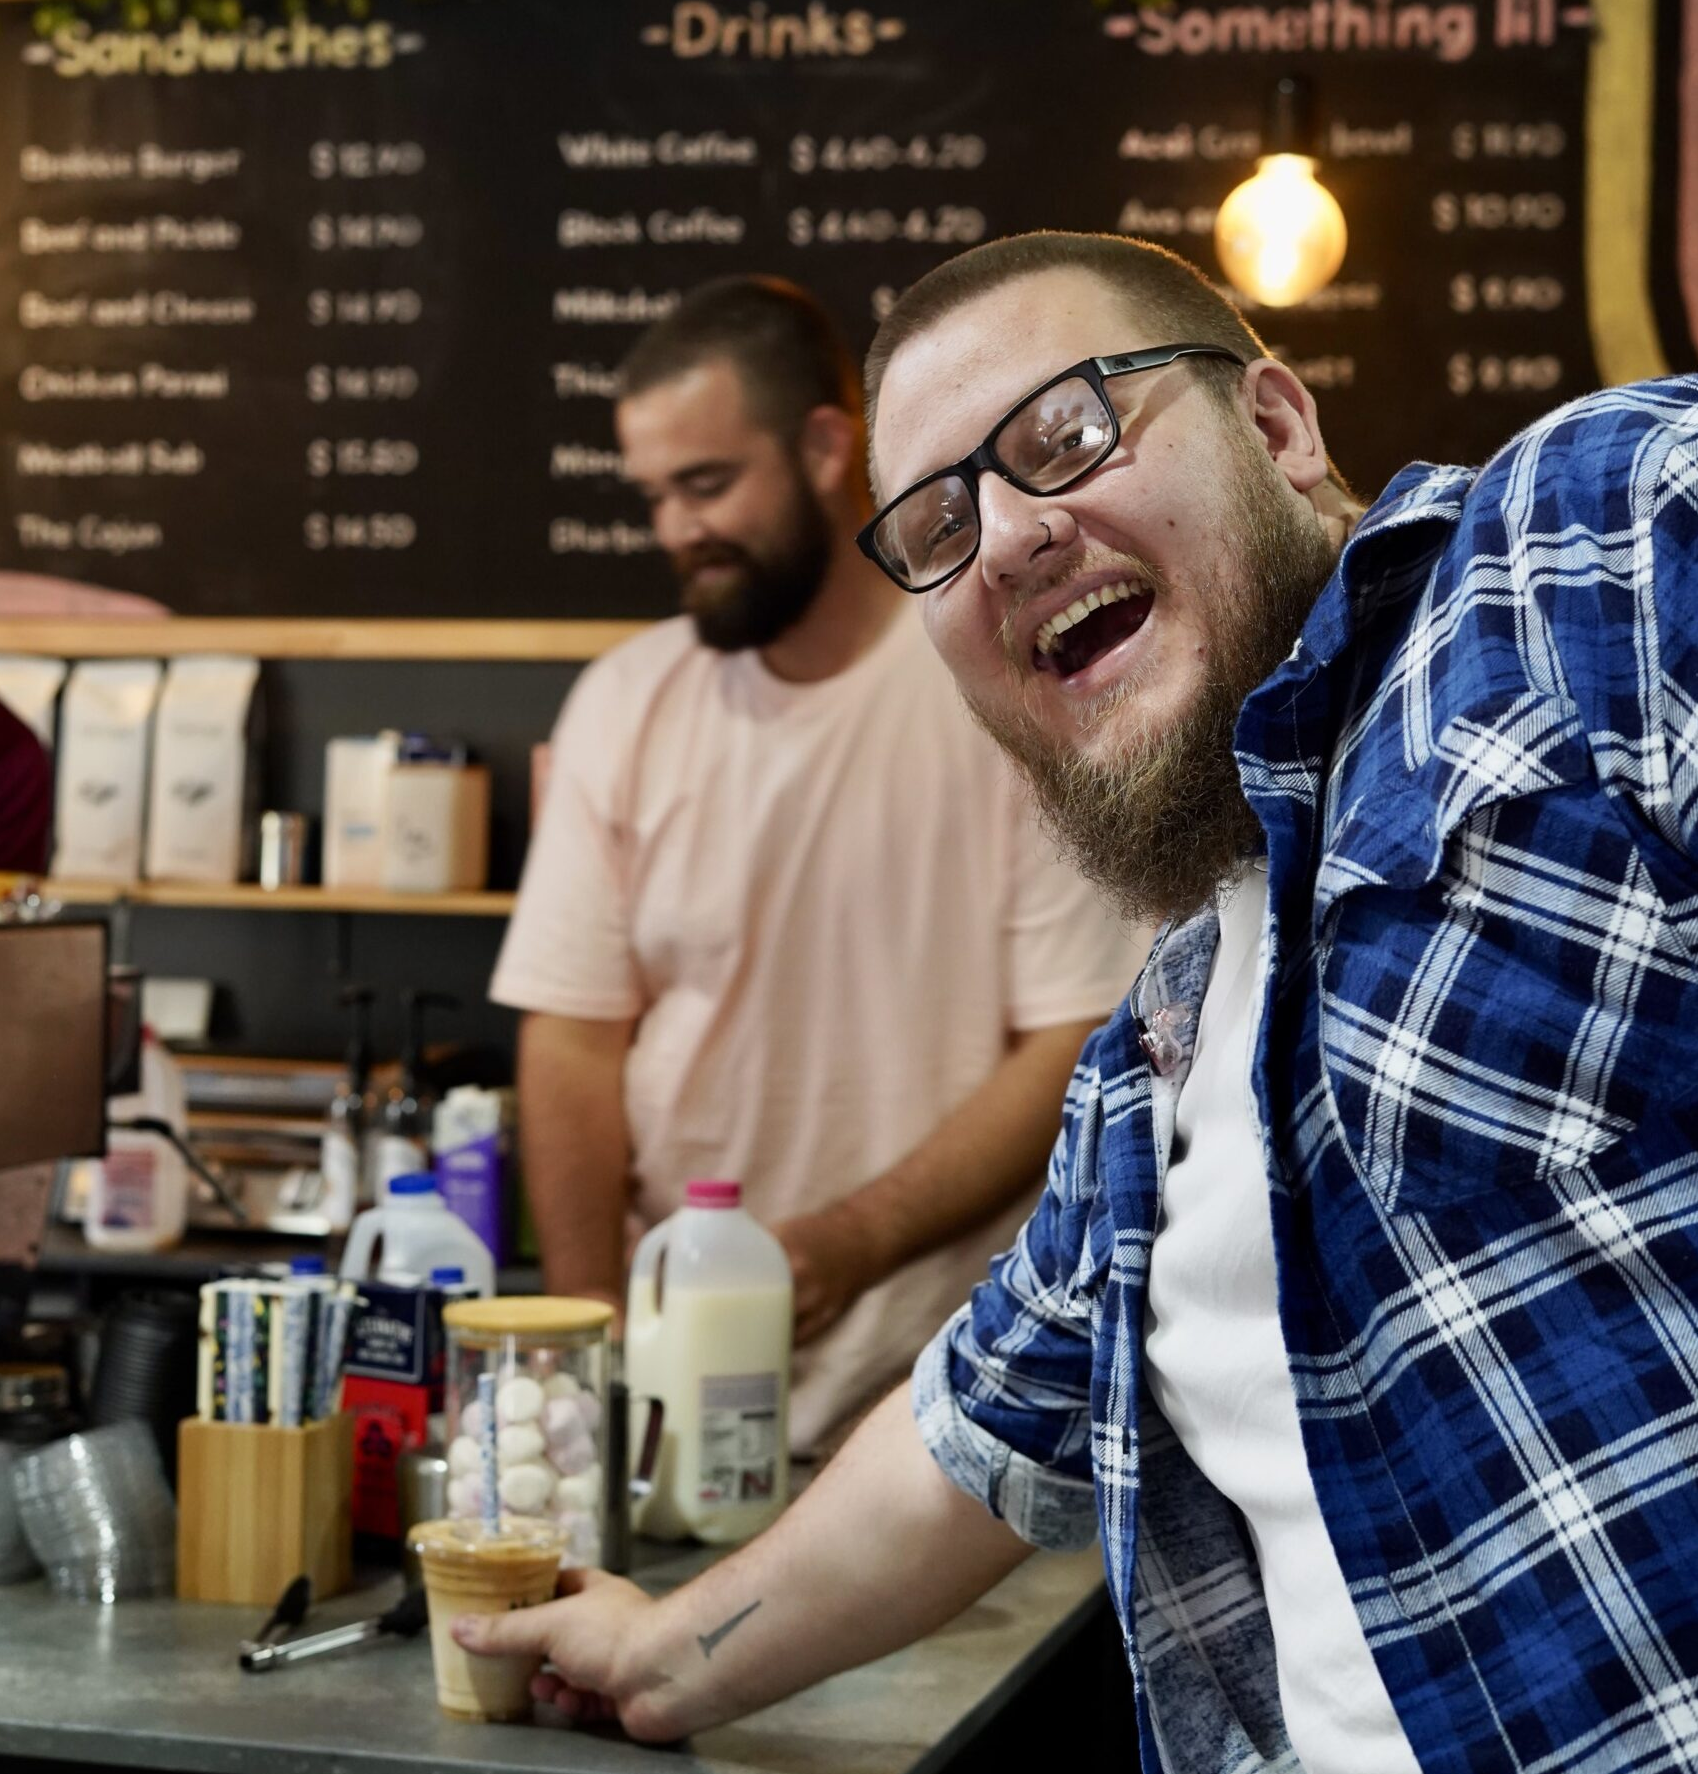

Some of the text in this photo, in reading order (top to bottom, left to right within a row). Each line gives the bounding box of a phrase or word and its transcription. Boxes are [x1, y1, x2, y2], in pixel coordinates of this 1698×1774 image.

[558, 130, 757, 168] White Coffee
[790, 134, 816, 172] $
[1118, 123, 1193, 158] Acai
[1331, 119, 1413, 157] bowl
[1454, 123, 1475, 159] $
[139, 144, 242, 182] Burger
[311, 141, 334, 179] $
[558, 207, 745, 247] Black Coffee
[790, 207, 813, 246] $
[1433, 193, 1458, 232] $
[21, 218, 88, 254] Beef
[91, 221, 149, 251] and
[311, 214, 334, 251] $
[20, 290, 256, 327] Beef and Cheese
[309, 290, 332, 326] $
[1450, 273, 1475, 312] $
[20, 364, 136, 400] Chicken
[307, 365, 331, 402] $
[1448, 355, 1473, 394] $
[18, 439, 203, 475] Meatball Sub
[307, 439, 331, 476] $
[17, 513, 162, 554] The Cajun
[304, 512, 330, 550] $
